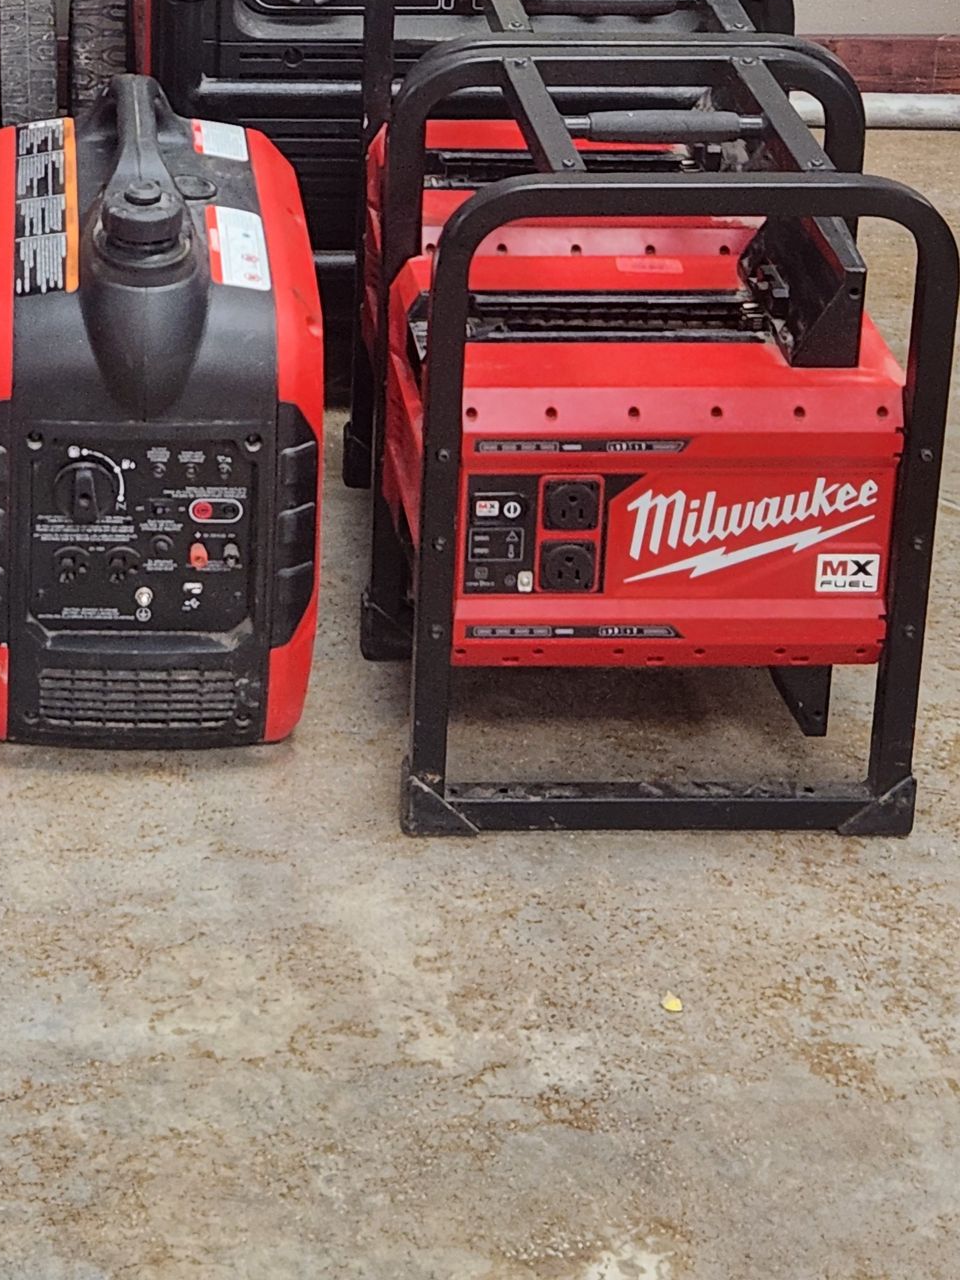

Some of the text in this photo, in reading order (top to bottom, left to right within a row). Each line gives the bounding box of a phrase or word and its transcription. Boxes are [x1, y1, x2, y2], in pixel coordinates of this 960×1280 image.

[627, 477, 879, 561] Milwaukee
[821, 559, 874, 577] MX
[820, 579, 873, 589] FUEL
